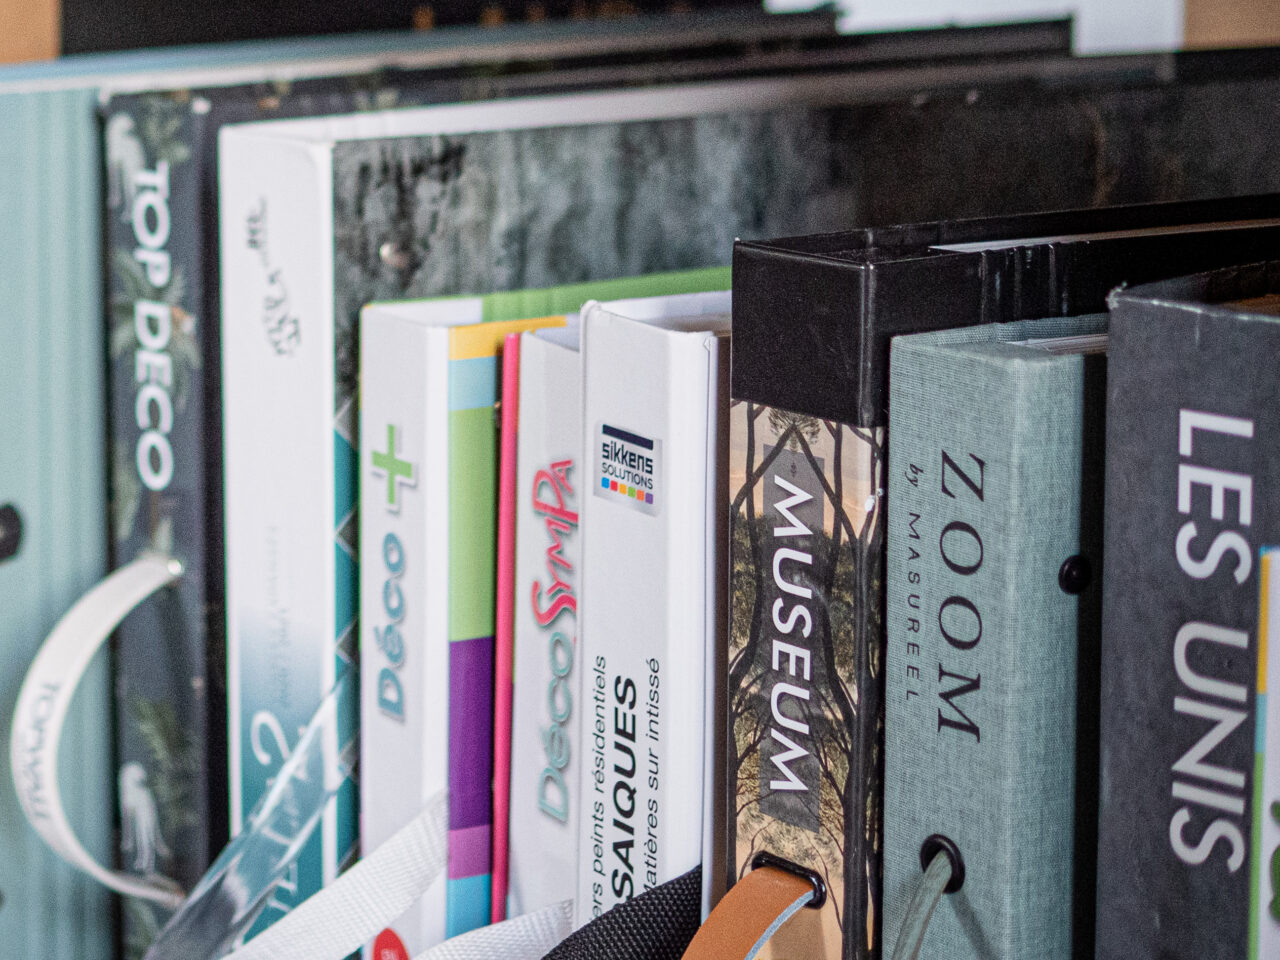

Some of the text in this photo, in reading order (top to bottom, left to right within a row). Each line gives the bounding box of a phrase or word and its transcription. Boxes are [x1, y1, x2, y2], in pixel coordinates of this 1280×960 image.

[132, 160, 174, 491] TOP DECO
[601, 462, 654, 490] SOLUTIONS
[602, 441, 654, 475] sikkens
[373, 531, 406, 722] Déco
[769, 474, 814, 791] MUSEUM
[904, 462, 925, 702] by MASUREEL
[937, 449, 986, 743] ZOOM
[1169, 408, 1255, 874] LES UNIS
[592, 655, 607, 794] résidentiels
[611, 675, 638, 906] SAIQUES
[645, 657, 661, 742] intissé
[647, 748, 659, 791] sur
[591, 800, 605, 877] peints
